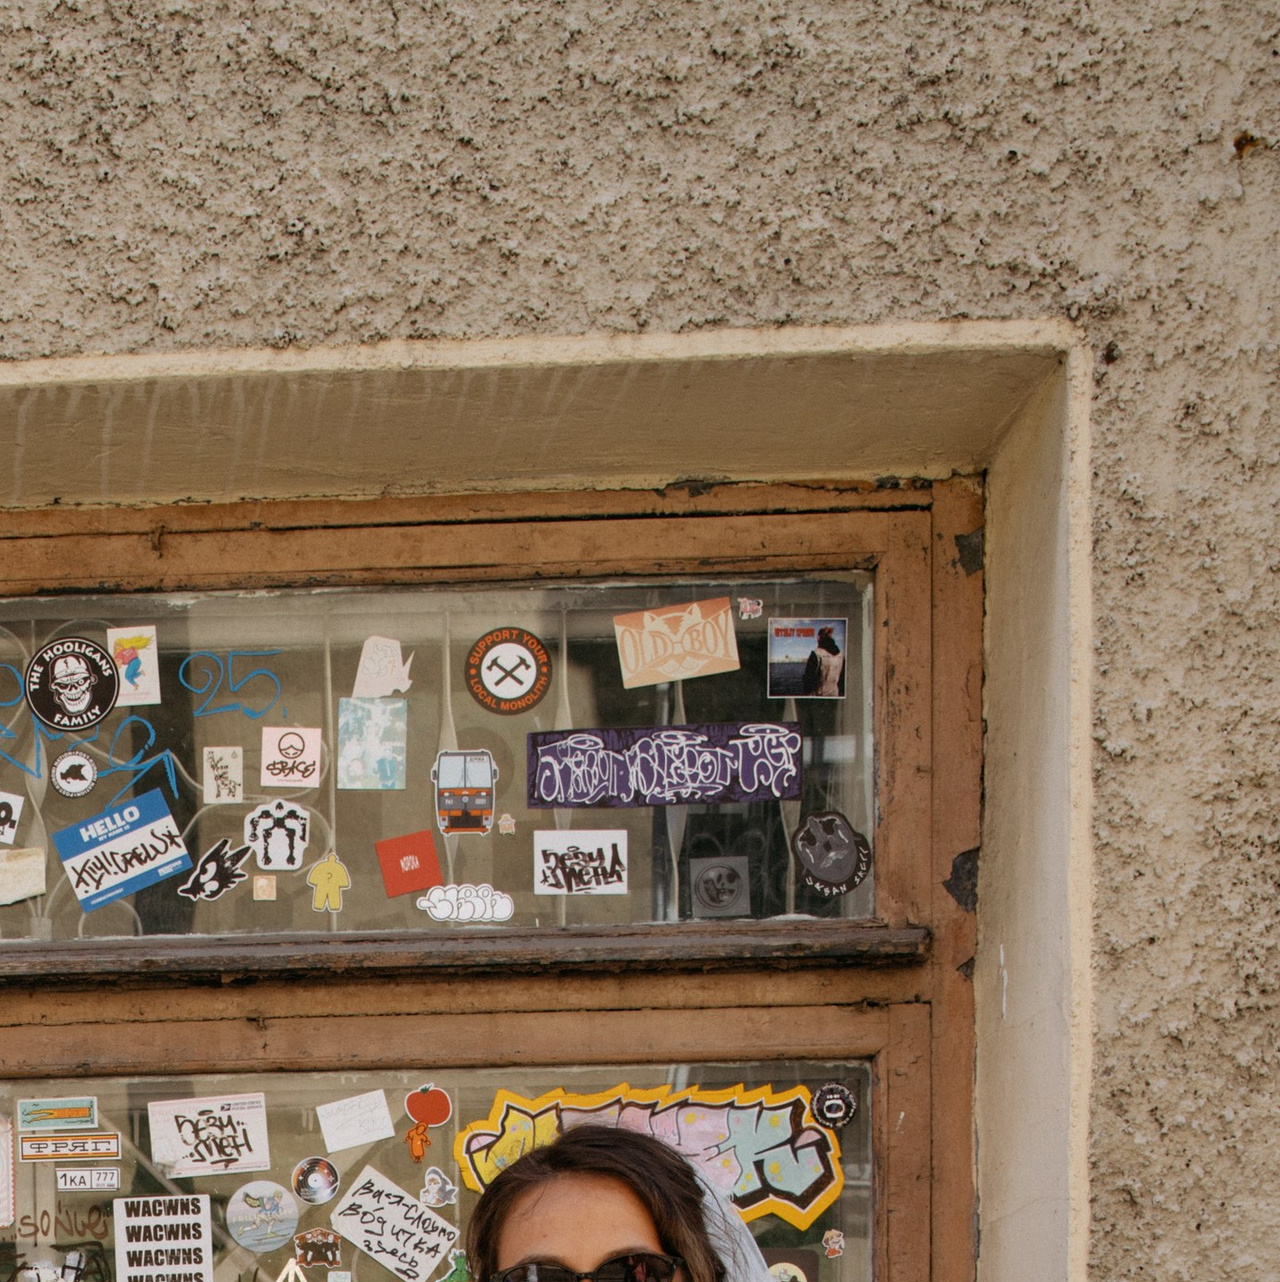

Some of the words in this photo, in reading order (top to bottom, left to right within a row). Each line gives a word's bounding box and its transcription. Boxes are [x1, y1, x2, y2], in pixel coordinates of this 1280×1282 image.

[469, 630, 519, 665] SUPPORT
[523, 633, 548, 663] YOUR
[30, 664, 44, 692] THE
[43, 642, 113, 677] HOOLIGANS
[470, 678, 497, 708] LOCAL
[500, 675, 548, 710] MONOLITH
[53, 705, 102, 726] FAMILY
[79, 806, 140, 842] HELLO
[96, 1172, 115, 1182] 777
